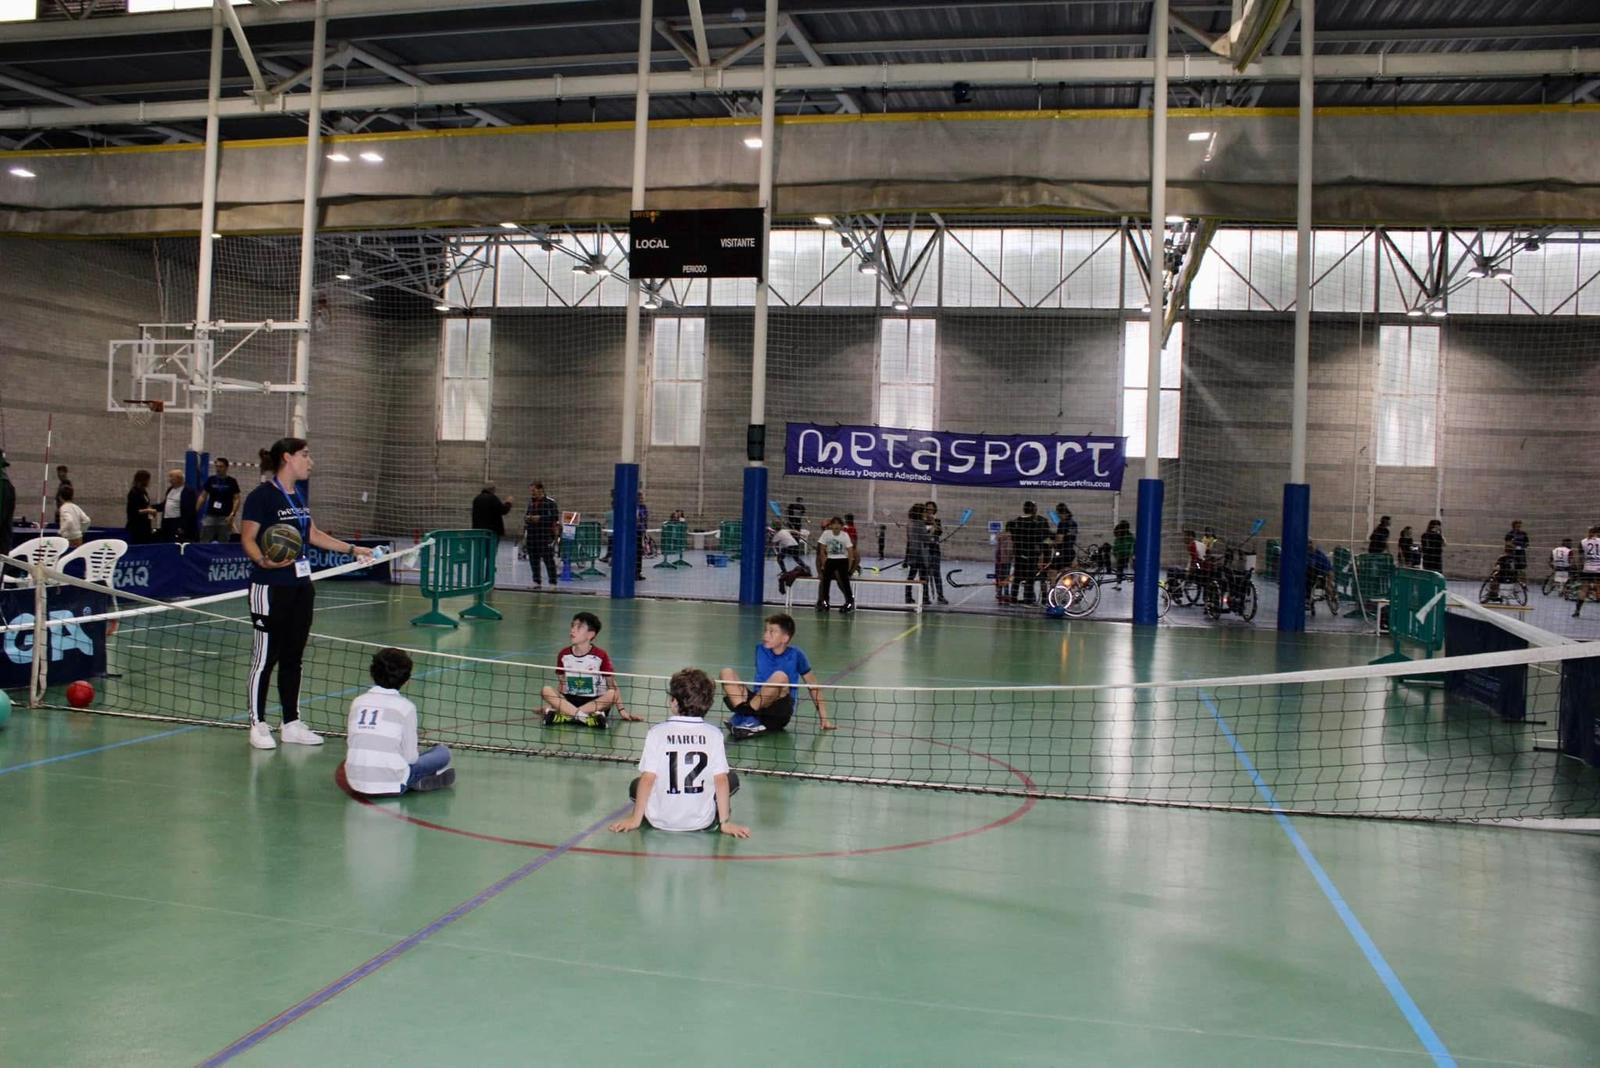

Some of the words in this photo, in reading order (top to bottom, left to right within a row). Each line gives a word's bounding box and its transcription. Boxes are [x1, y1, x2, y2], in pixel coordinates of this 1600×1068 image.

[635, 239, 669, 249] LOCAL
[720, 238, 755, 248] VISITANTE
[682, 265, 707, 273] PERIODO
[798, 466, 833, 475] Actividad
[856, 470, 863, 478] y
[864, 470, 893, 479] Deporte
[895, 472, 931, 481] Adaptado
[1587, 543, 1599, 556] 21
[113, 566, 149, 588] RAQ
[358, 709, 378, 725] 11
[666, 735, 706, 745] MARCO
[666, 751, 708, 794] 12
